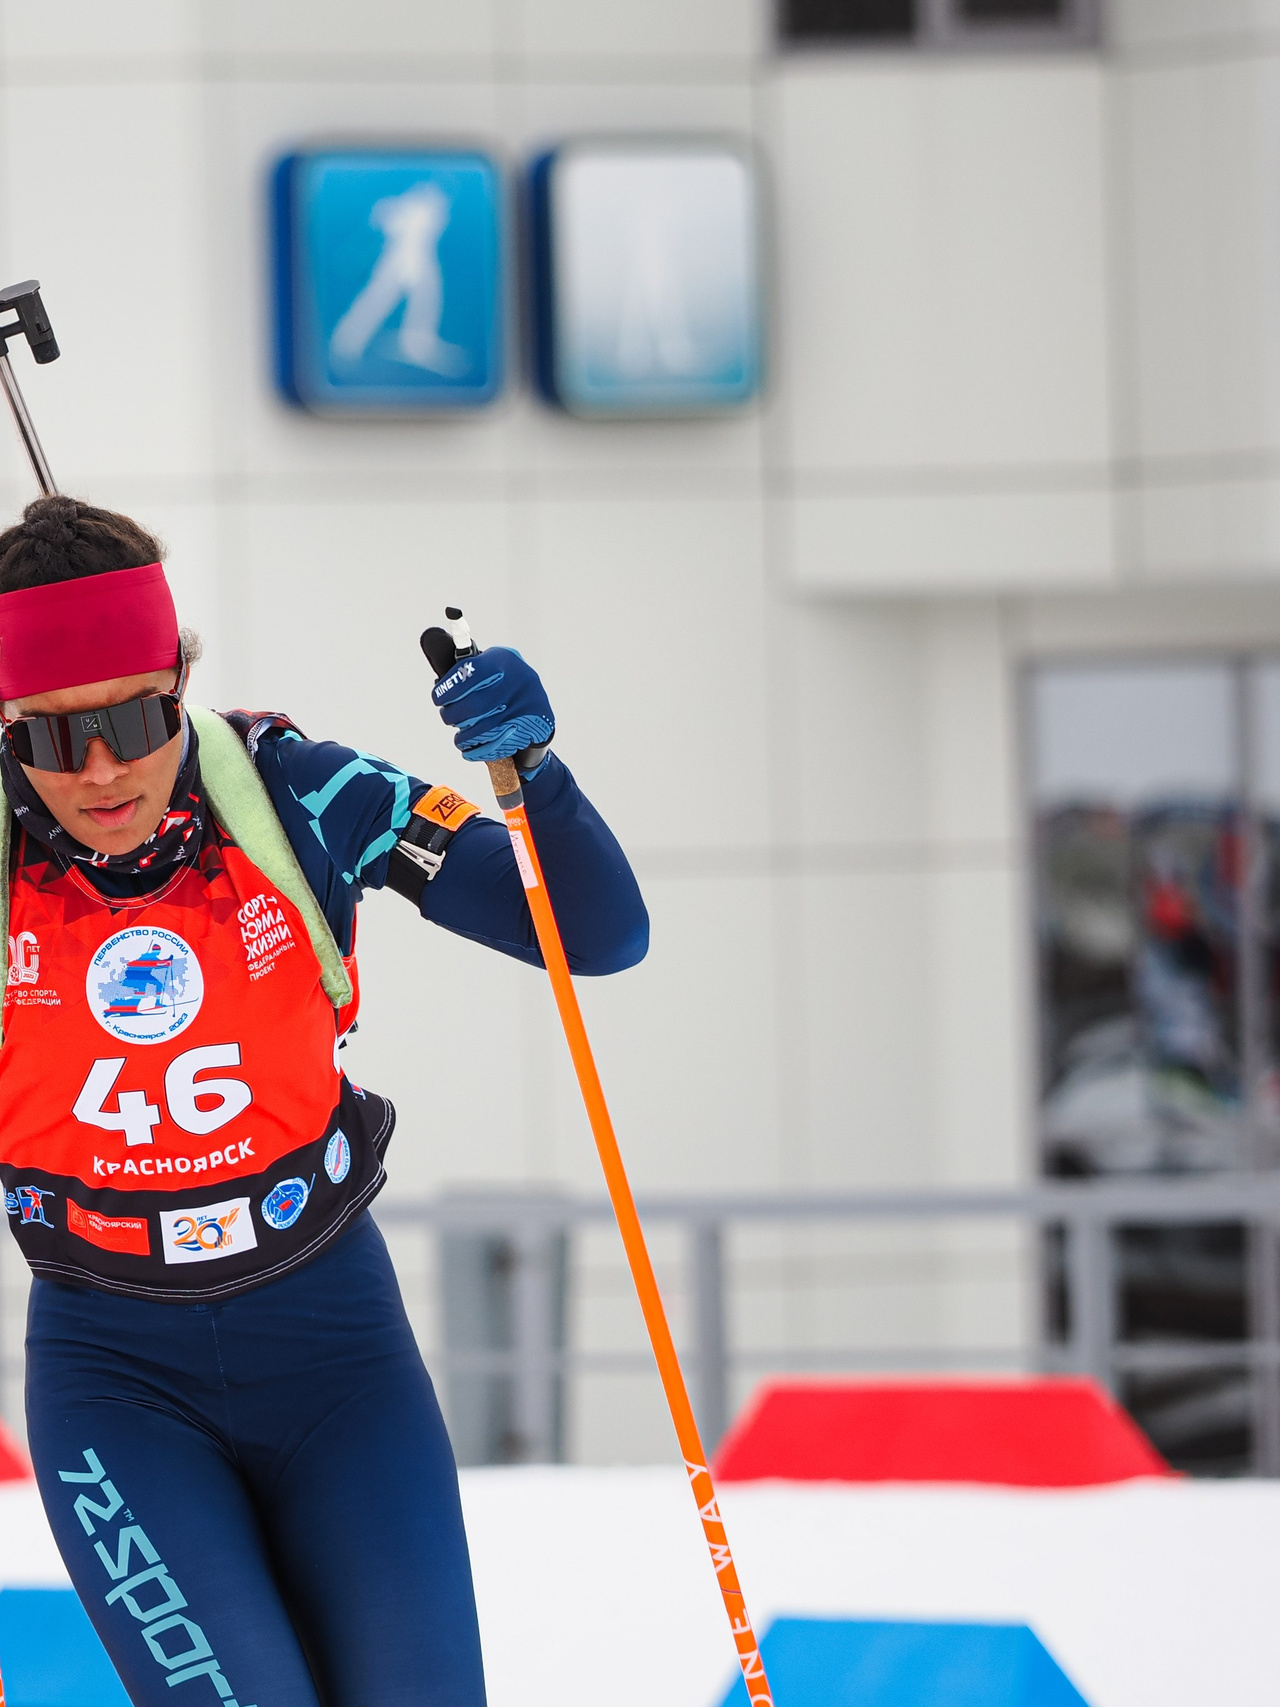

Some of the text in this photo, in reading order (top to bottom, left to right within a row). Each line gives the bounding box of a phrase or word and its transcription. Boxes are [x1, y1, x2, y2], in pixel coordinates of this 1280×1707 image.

[93, 929, 189, 966] ПЕРВЕНСТВО РОССИИ
[244, 924, 292, 961] ЖИЗНИ
[249, 962, 275, 981] ПРОЕКТ
[112, 1024, 166, 1040] Красноярск
[168, 1012, 189, 1032] 2023
[72, 1042, 253, 1147] 46
[93, 1137, 256, 1177] КРАСНОЯРСК
[684, 1458, 733, 1573] WAY
